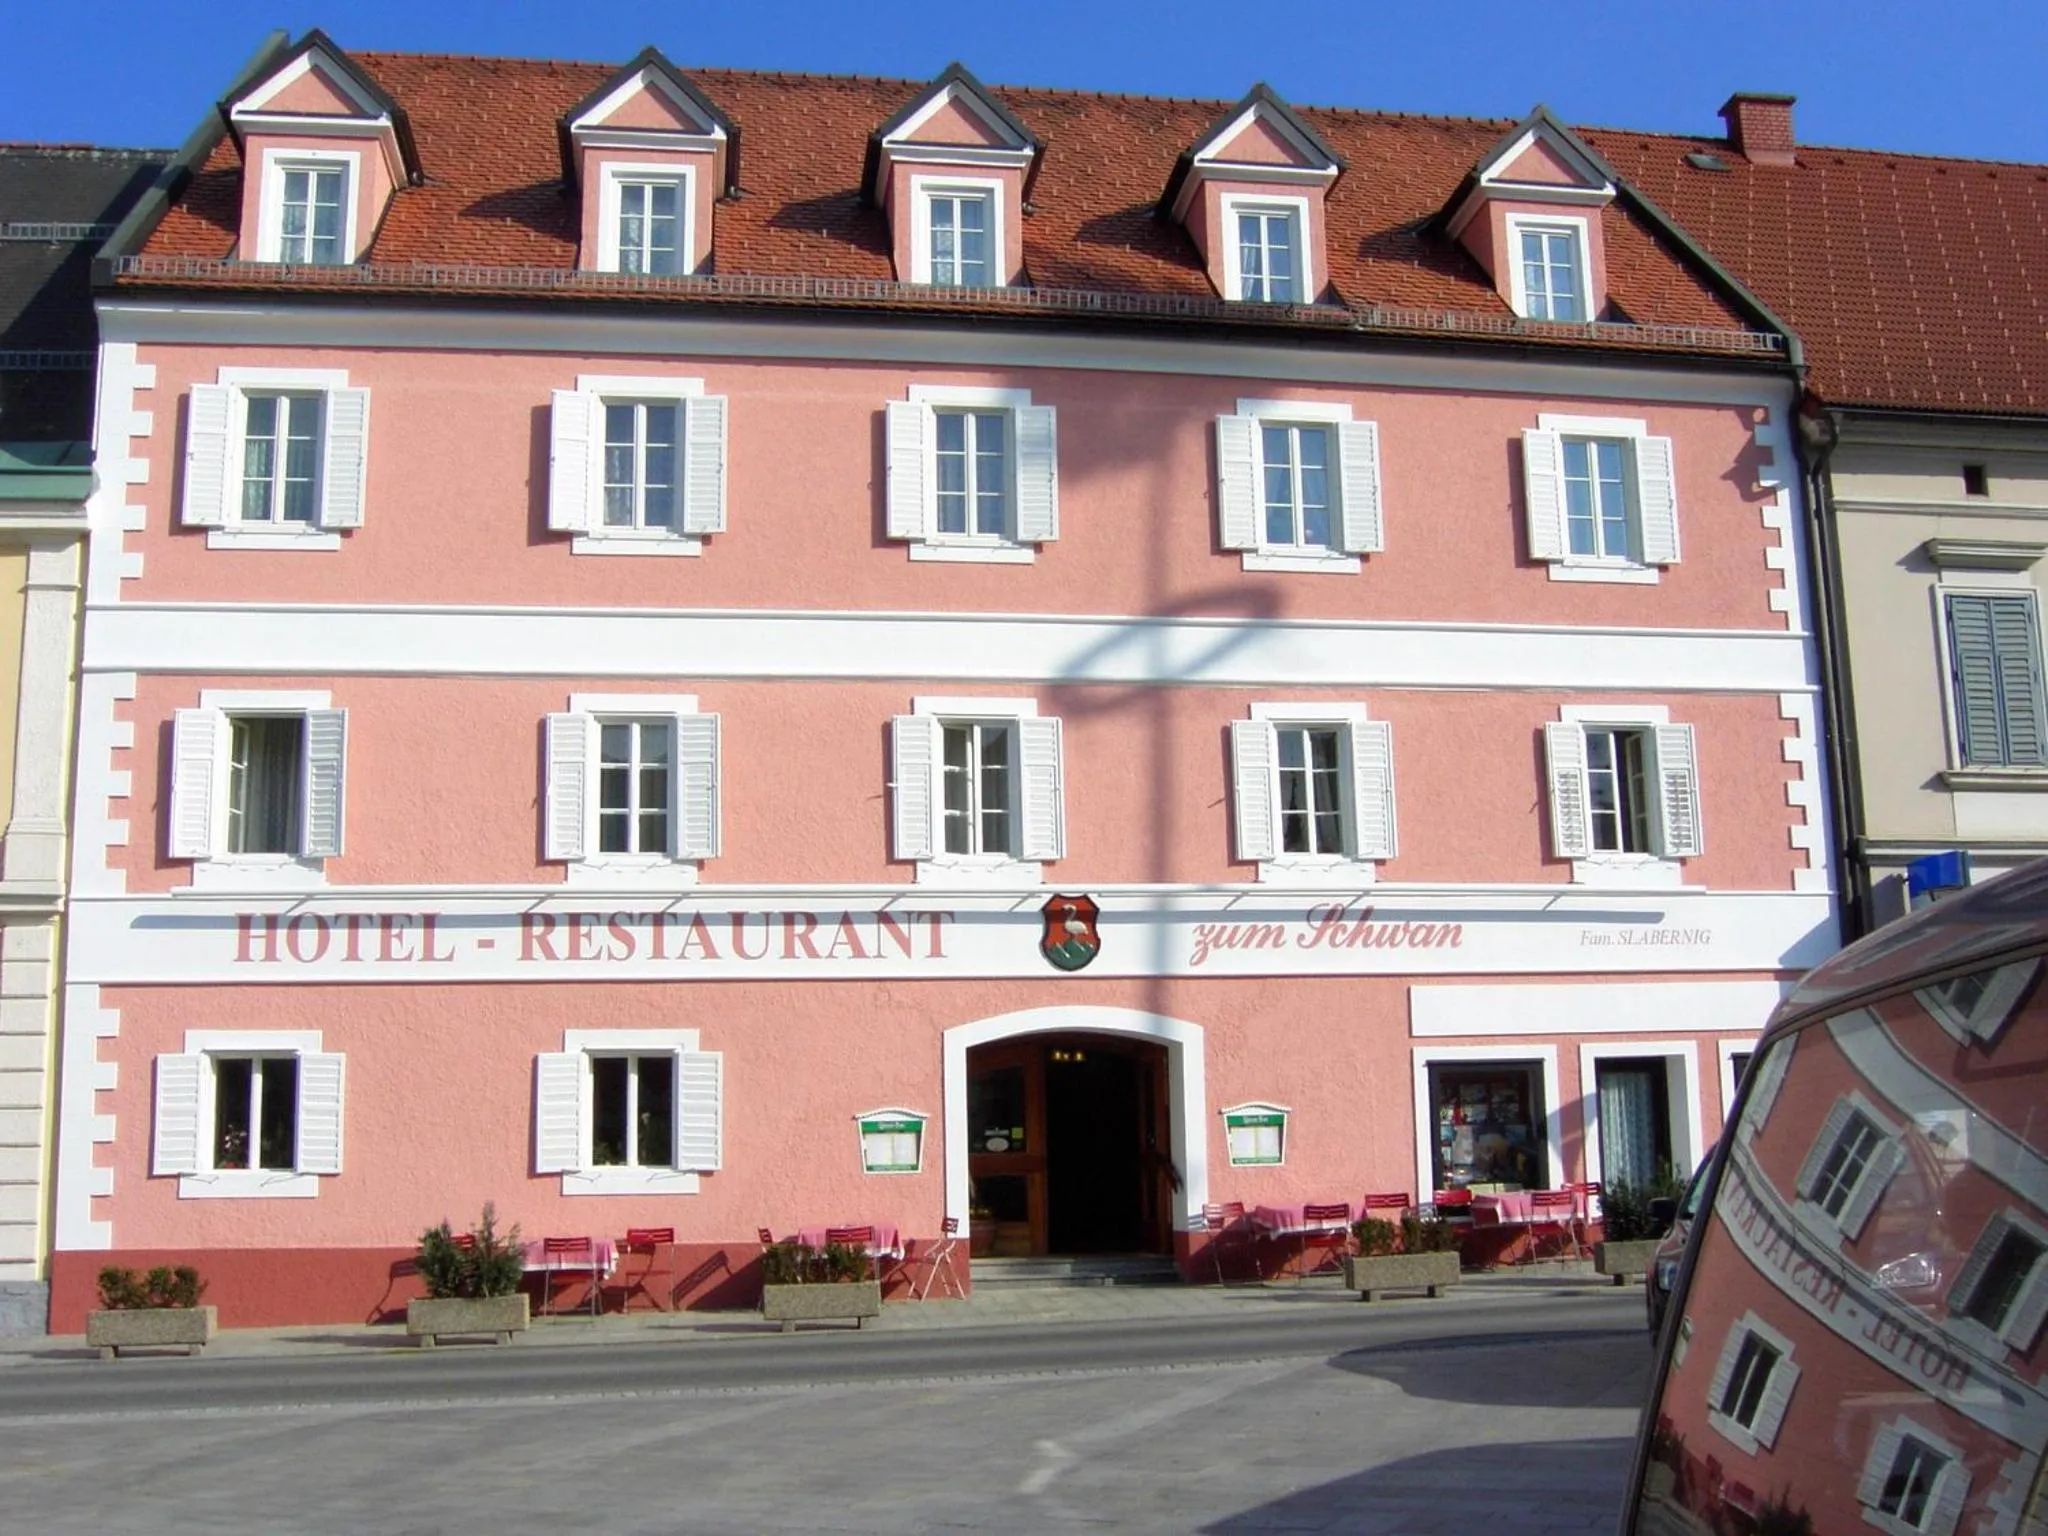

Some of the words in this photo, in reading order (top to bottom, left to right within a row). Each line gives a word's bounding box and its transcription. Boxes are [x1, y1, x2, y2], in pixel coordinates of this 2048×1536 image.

[234, 912, 455, 963] HOTEL
[477, 939, 495, 949] -
[516, 910, 955, 961] RESTAURANT
[1189, 922, 1286, 966] zum
[1297, 903, 1462, 949] Schwan
[1580, 929, 1615, 946] Fam.
[1618, 929, 1712, 945] SLABERNIG
